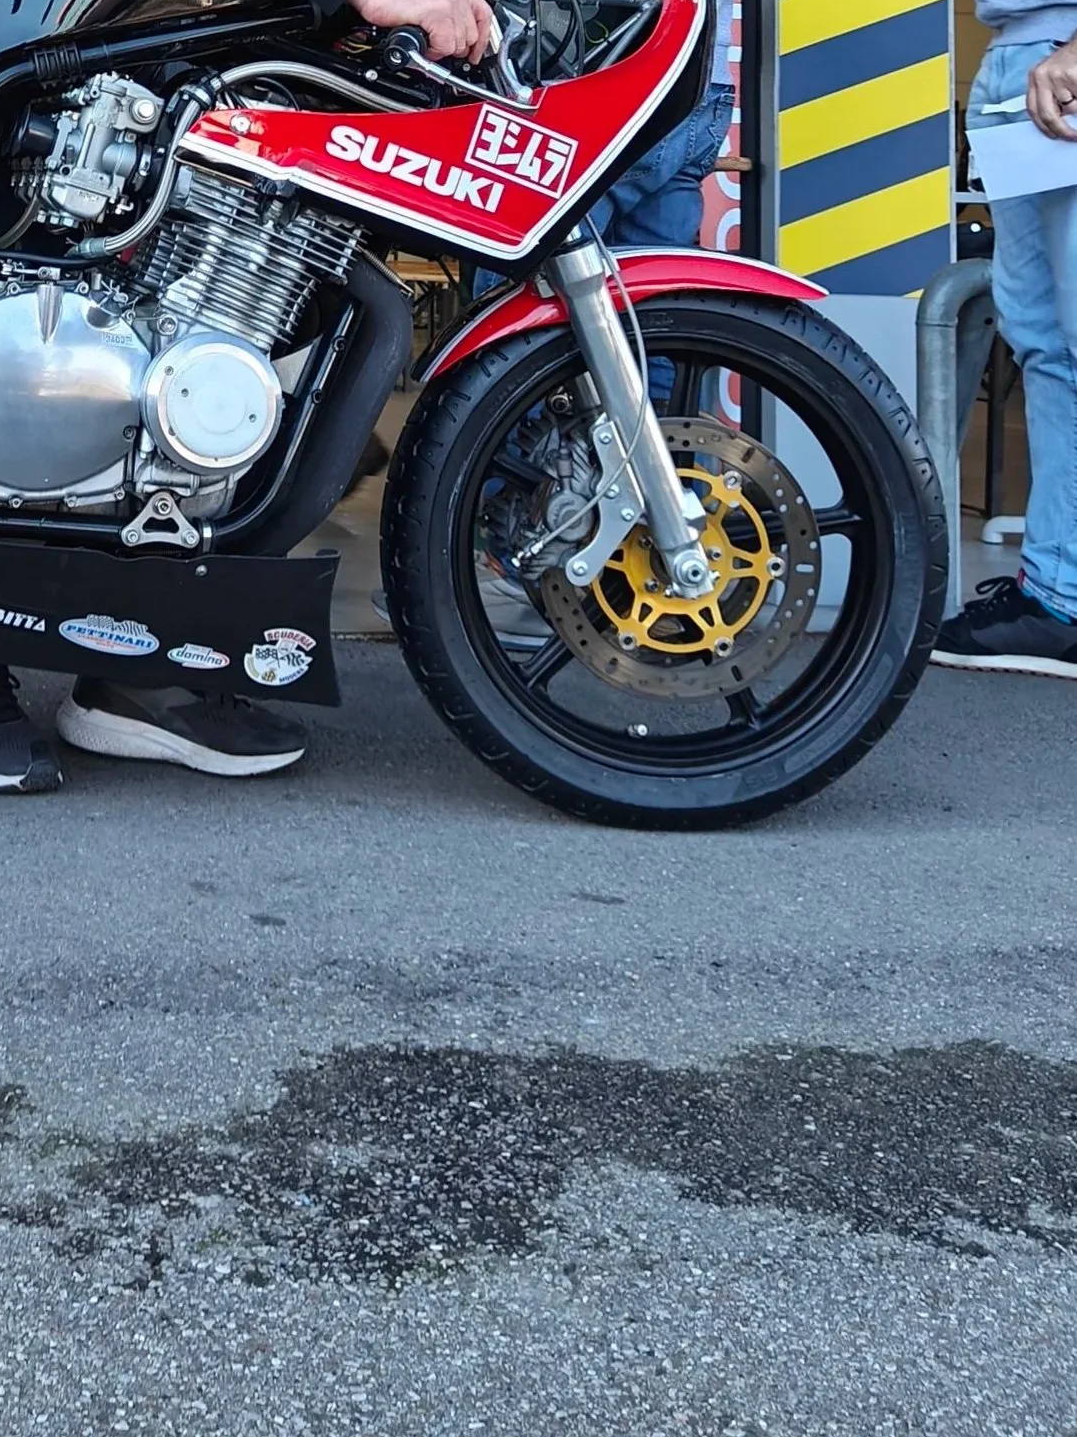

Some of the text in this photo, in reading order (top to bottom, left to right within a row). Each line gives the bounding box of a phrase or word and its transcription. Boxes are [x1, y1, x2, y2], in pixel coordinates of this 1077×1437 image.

[325, 124, 505, 214] SUZUKI
[65, 624, 154, 649] PETTINARI
[266, 630, 314, 649] SCUDERIA
[175, 645, 223, 666] domino
